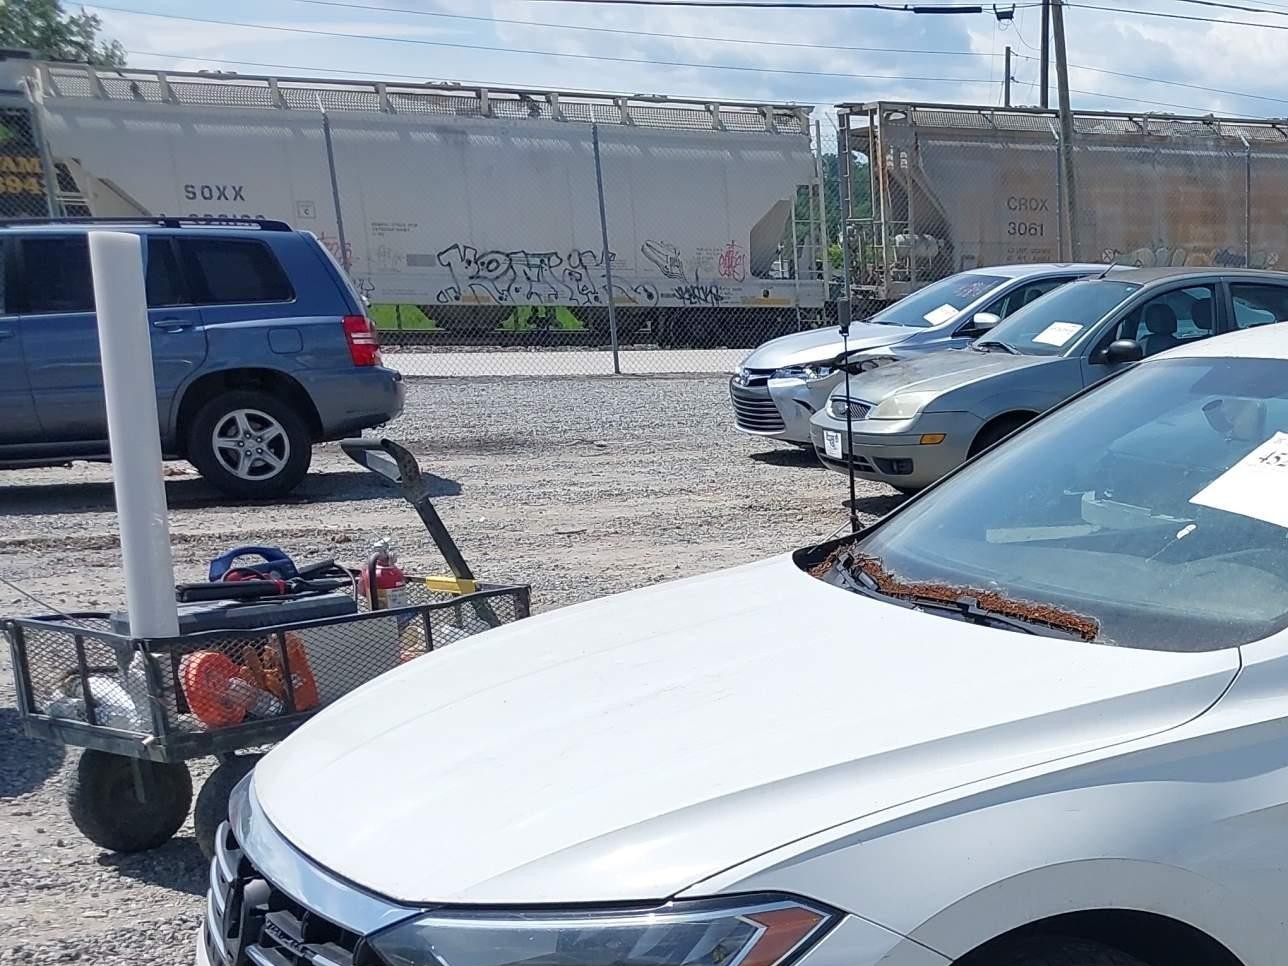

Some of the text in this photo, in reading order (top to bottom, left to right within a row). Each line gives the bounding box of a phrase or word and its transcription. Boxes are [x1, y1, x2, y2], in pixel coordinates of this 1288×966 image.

[184, 184, 246, 201] SOXX
[1006, 196, 1049, 212] CROX
[1007, 221, 1044, 237] 3061
